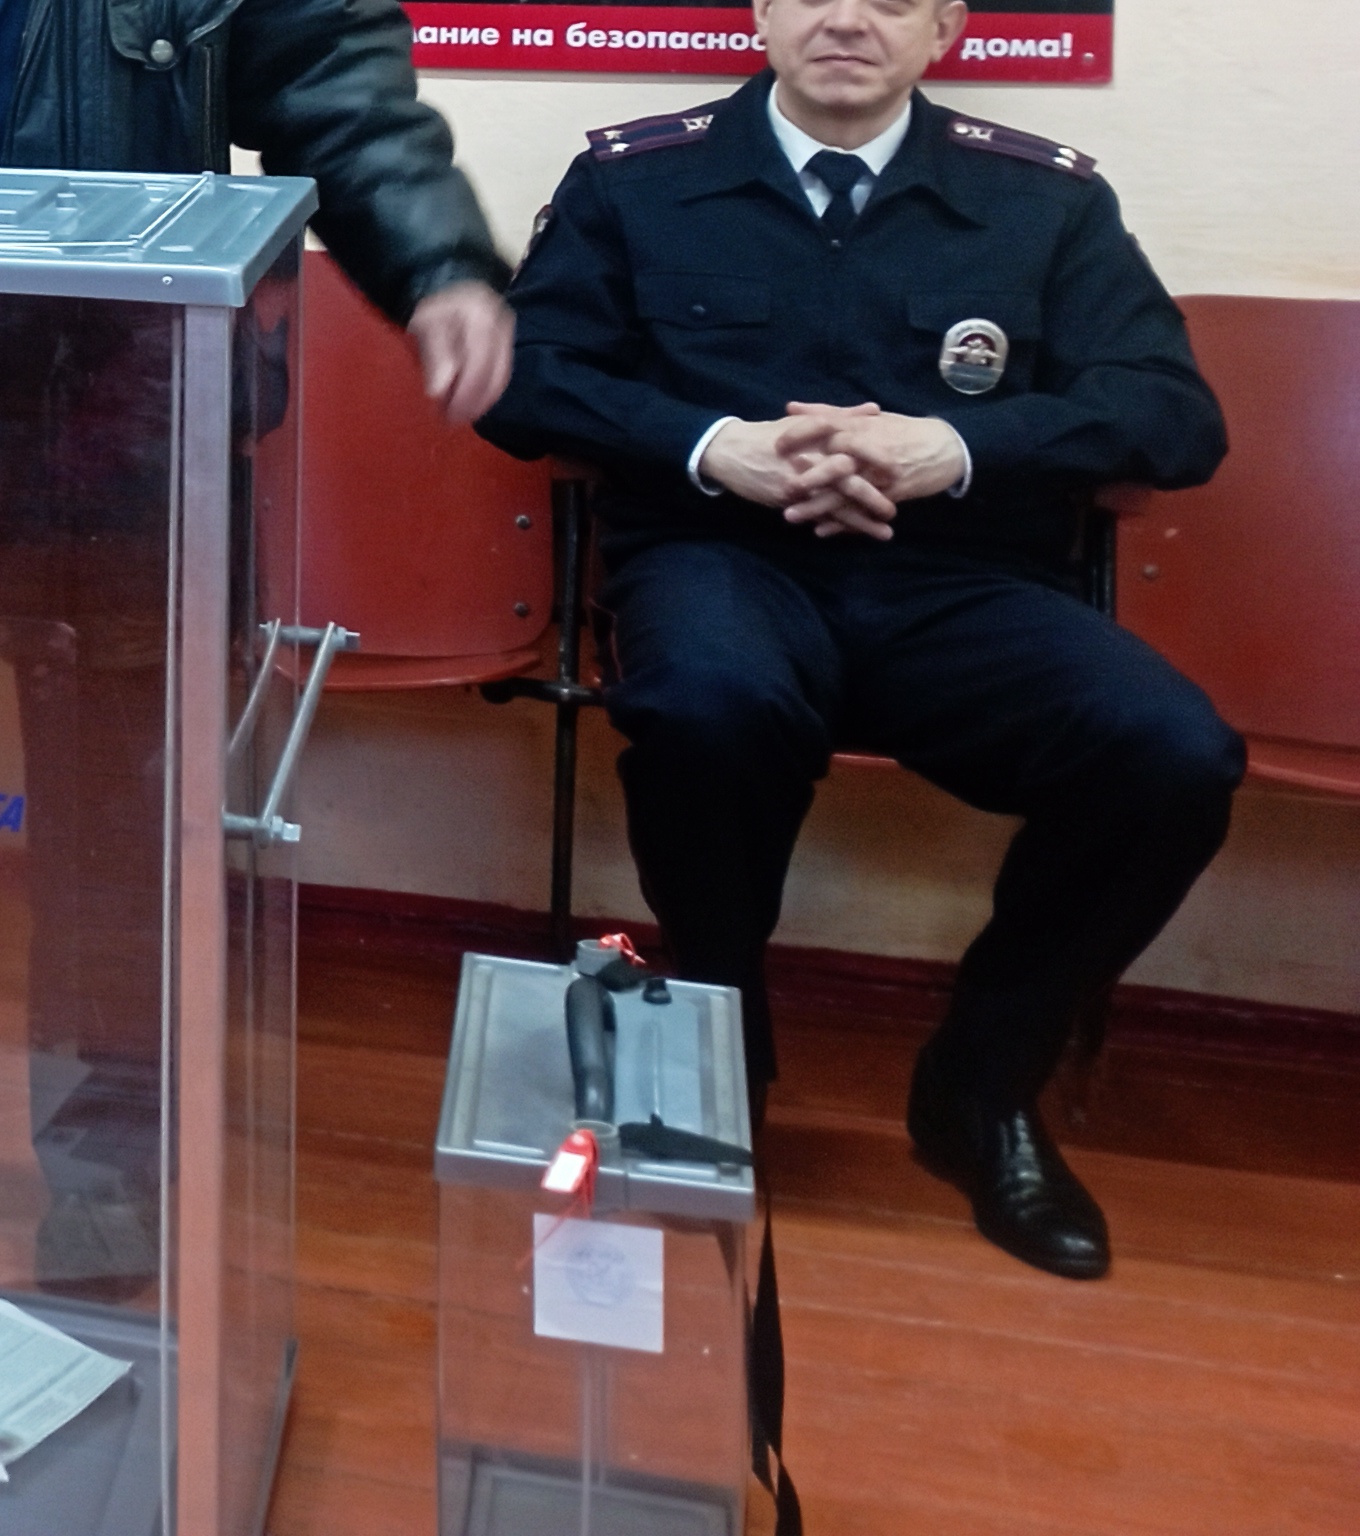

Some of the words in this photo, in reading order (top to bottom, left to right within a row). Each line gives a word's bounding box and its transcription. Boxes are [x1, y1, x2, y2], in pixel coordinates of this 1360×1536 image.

[511, 26, 555, 47] на
[566, 22, 769, 52] безопаснос
[960, 31, 1073, 62] дома!
